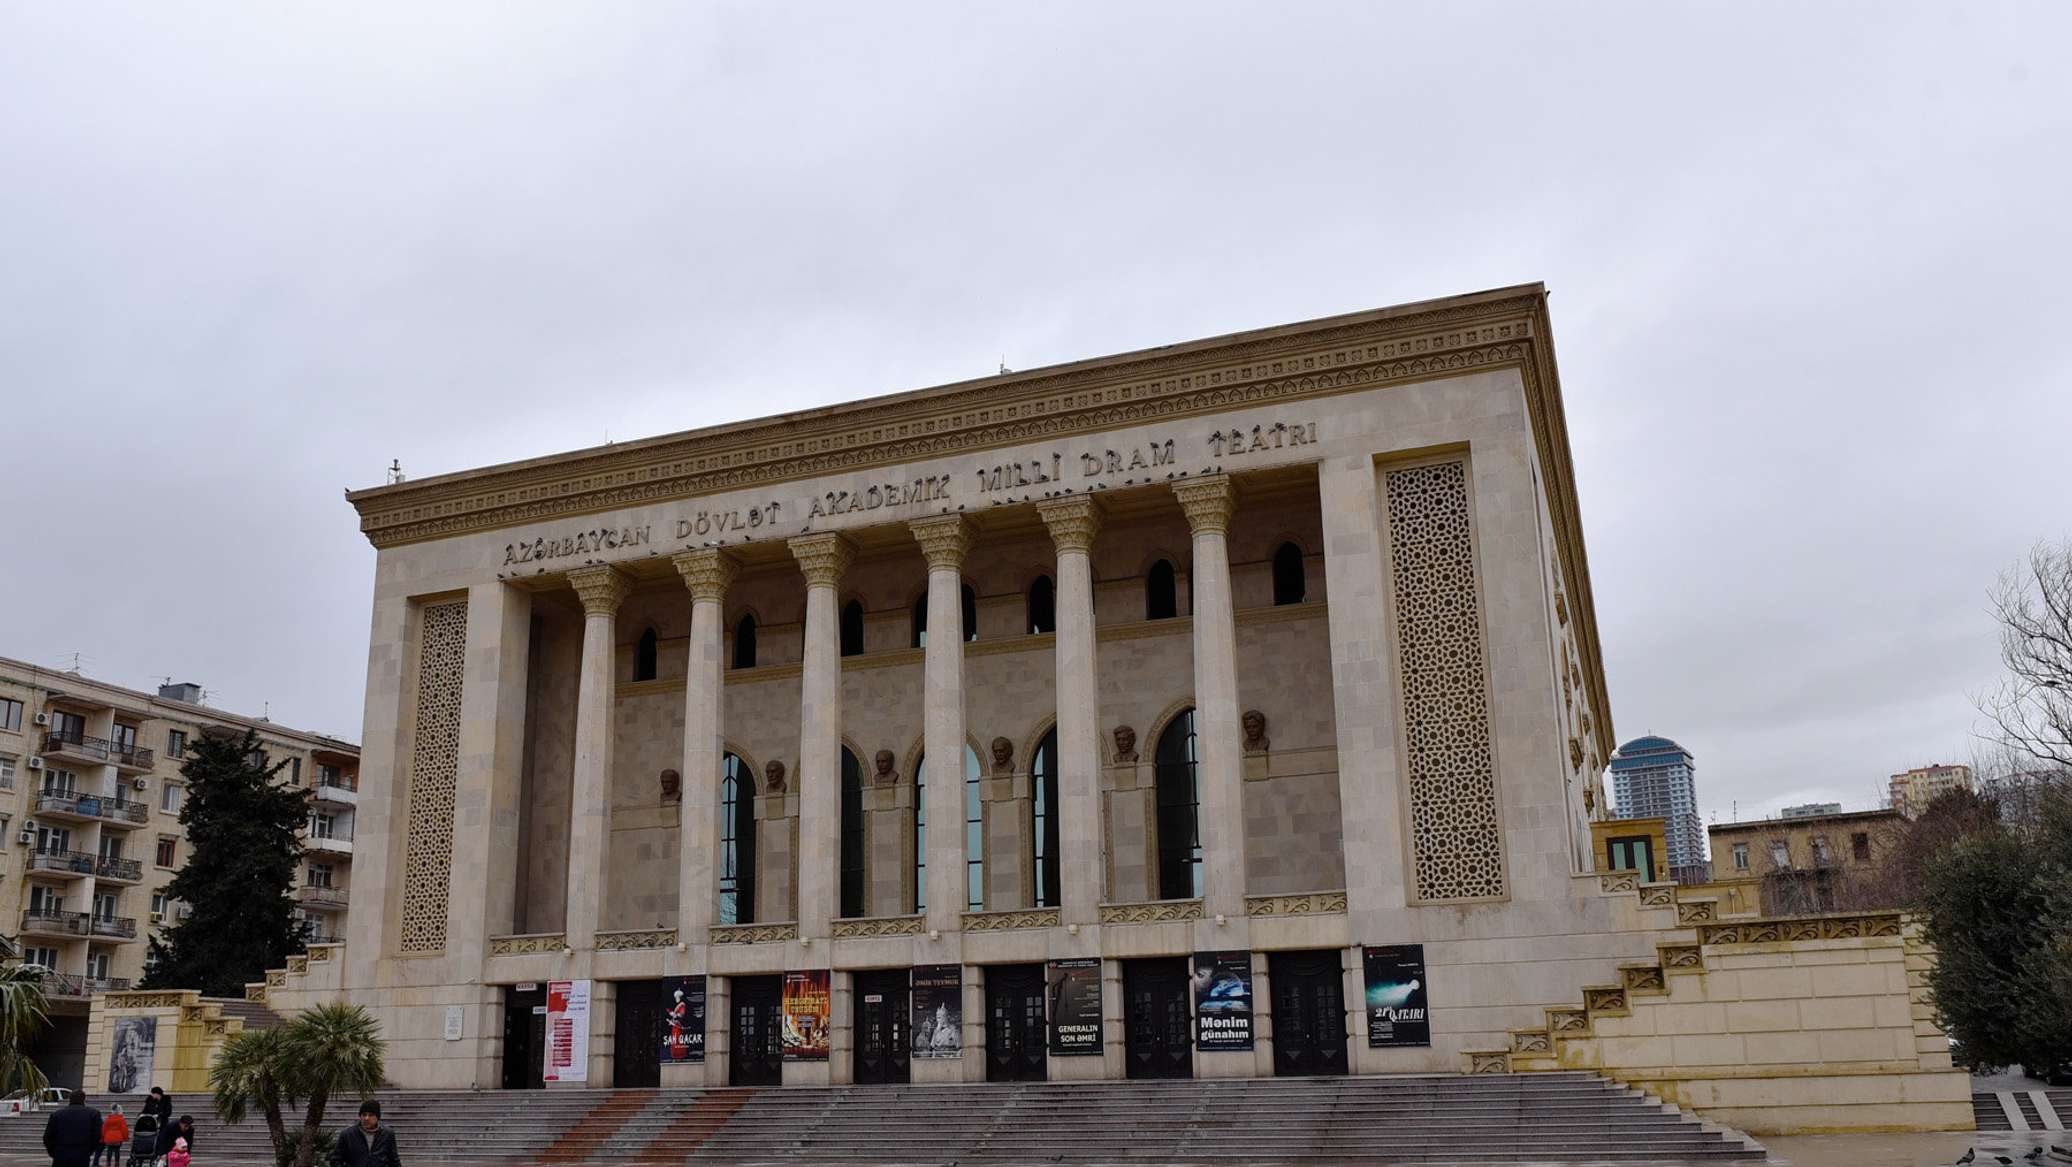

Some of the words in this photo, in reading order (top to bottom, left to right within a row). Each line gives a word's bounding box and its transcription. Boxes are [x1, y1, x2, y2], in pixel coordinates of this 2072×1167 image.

[1083, 442, 1175, 477] DRAM
[1201, 1016, 1248, 1028] Mənim
[1060, 1034, 1076, 1043] SON
